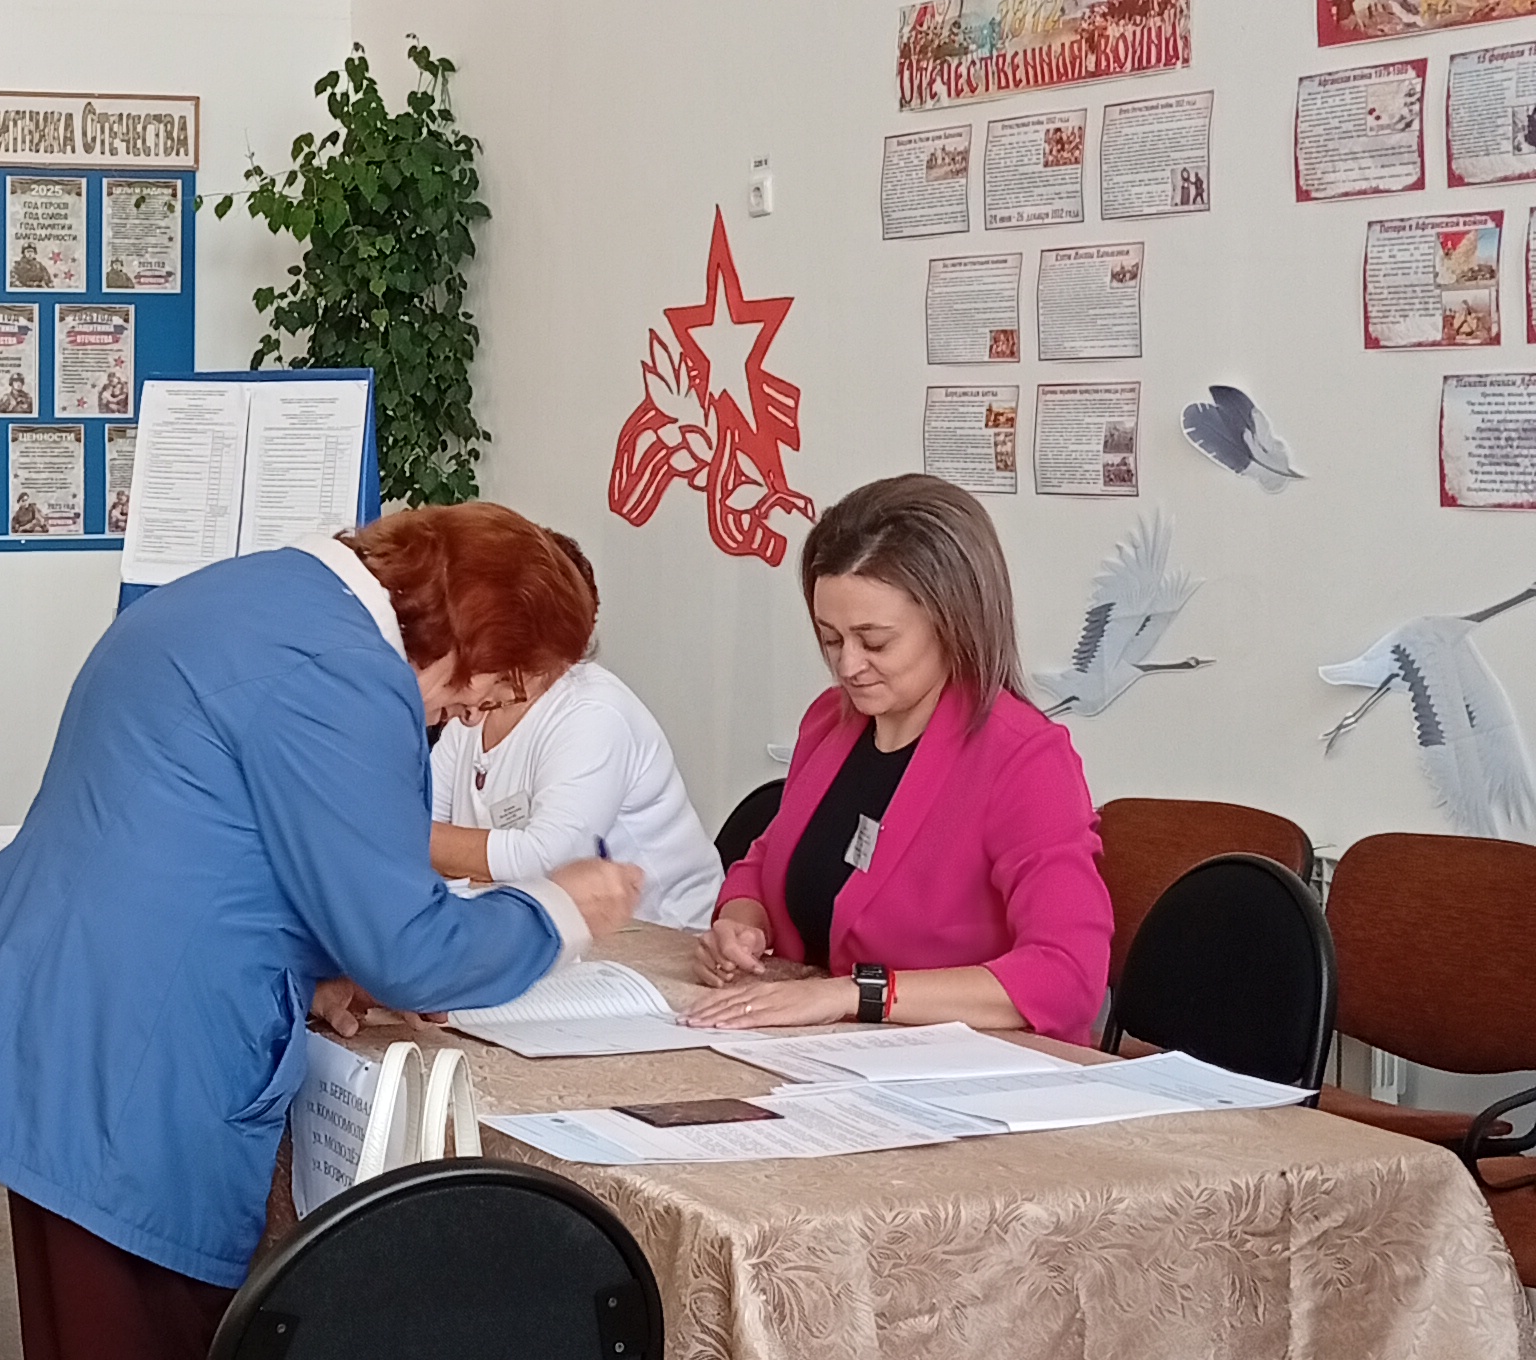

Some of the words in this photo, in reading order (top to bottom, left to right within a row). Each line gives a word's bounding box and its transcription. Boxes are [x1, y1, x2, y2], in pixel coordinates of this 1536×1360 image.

[899, 37, 1086, 106] ОТЕЧЕСТВЕННАЯ
[30, 184, 63, 197] 2025
[23, 201, 39, 210] ГОД
[23, 211, 40, 221] ГОД
[19, 222, 36, 231] ГОД
[1415, 219, 1460, 232] Афганской
[14, 232, 78, 242] БЛАГОДАРНОСТИ
[18, 432, 75, 442] ЦЕННОСТИ
